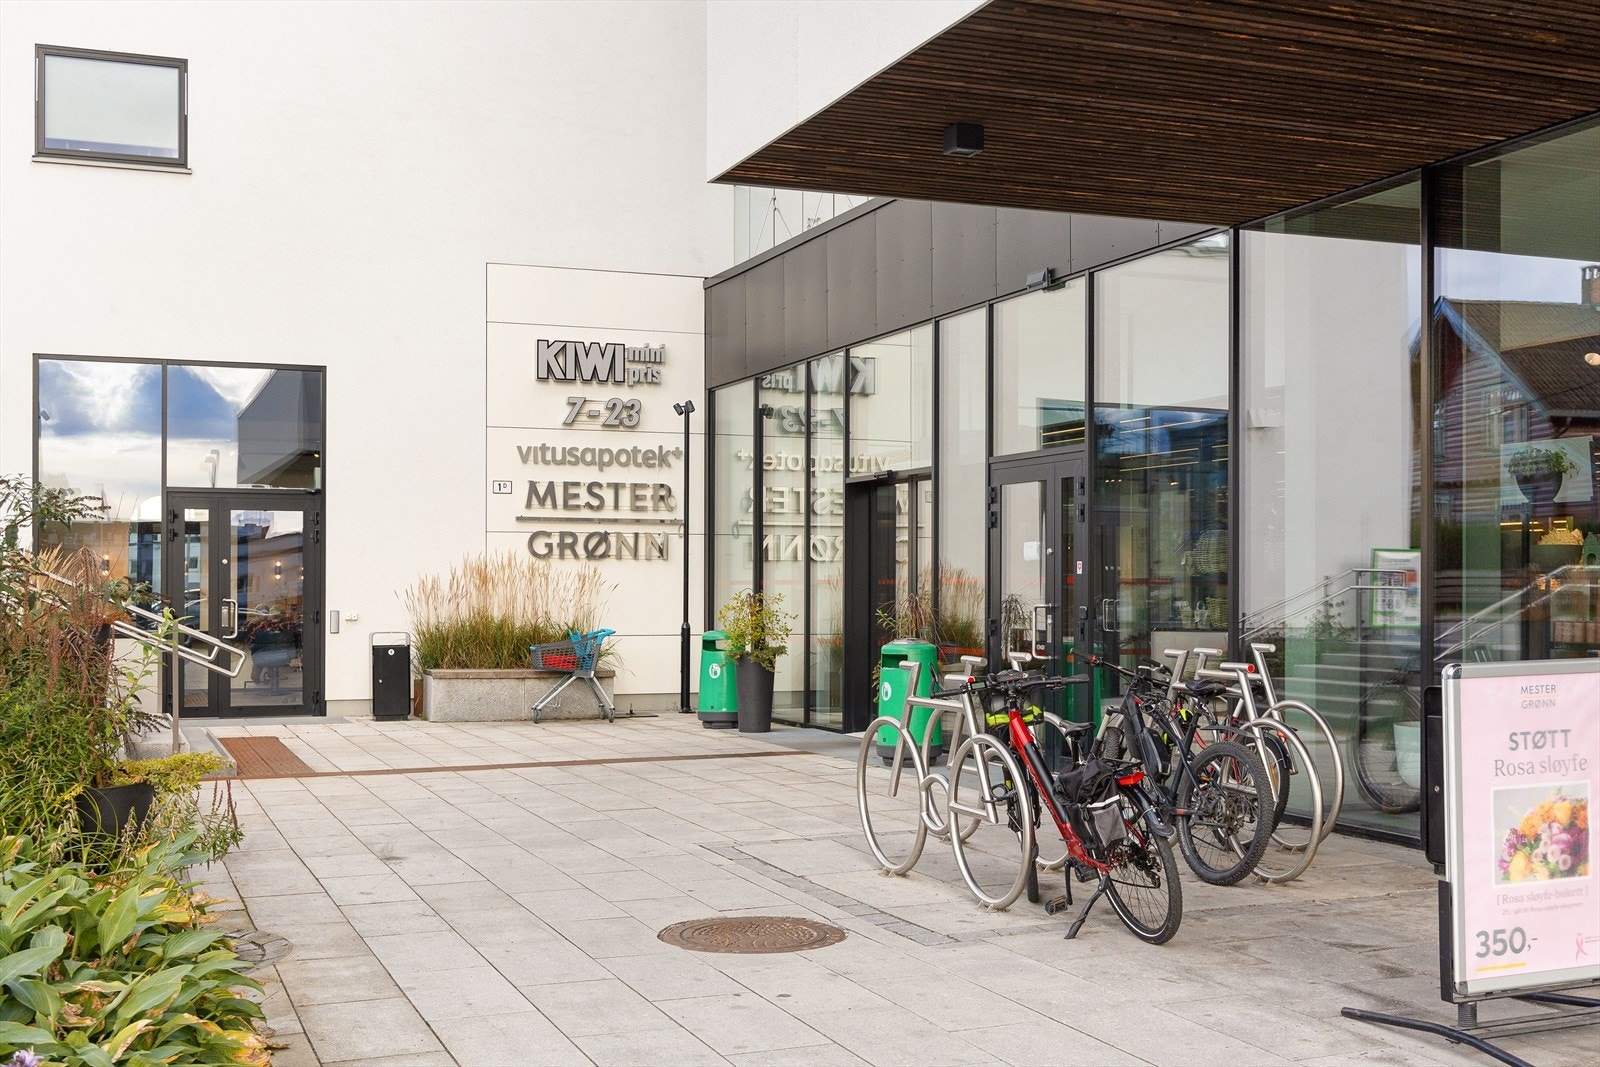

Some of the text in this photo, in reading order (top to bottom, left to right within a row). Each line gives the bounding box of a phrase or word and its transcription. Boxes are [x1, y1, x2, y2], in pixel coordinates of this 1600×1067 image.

[536, 339, 626, 384] KIWI
[627, 343, 666, 363] mini
[627, 364, 662, 386] pris
[525, 480, 674, 512] MESTER
[528, 530, 669, 562] GRØNN
[1520, 684, 1557, 695] MESTER
[1521, 699, 1556, 709] GRØNN
[1509, 729, 1572, 751] STØTT
[1494, 753, 1588, 777] Rosa sløyfe
